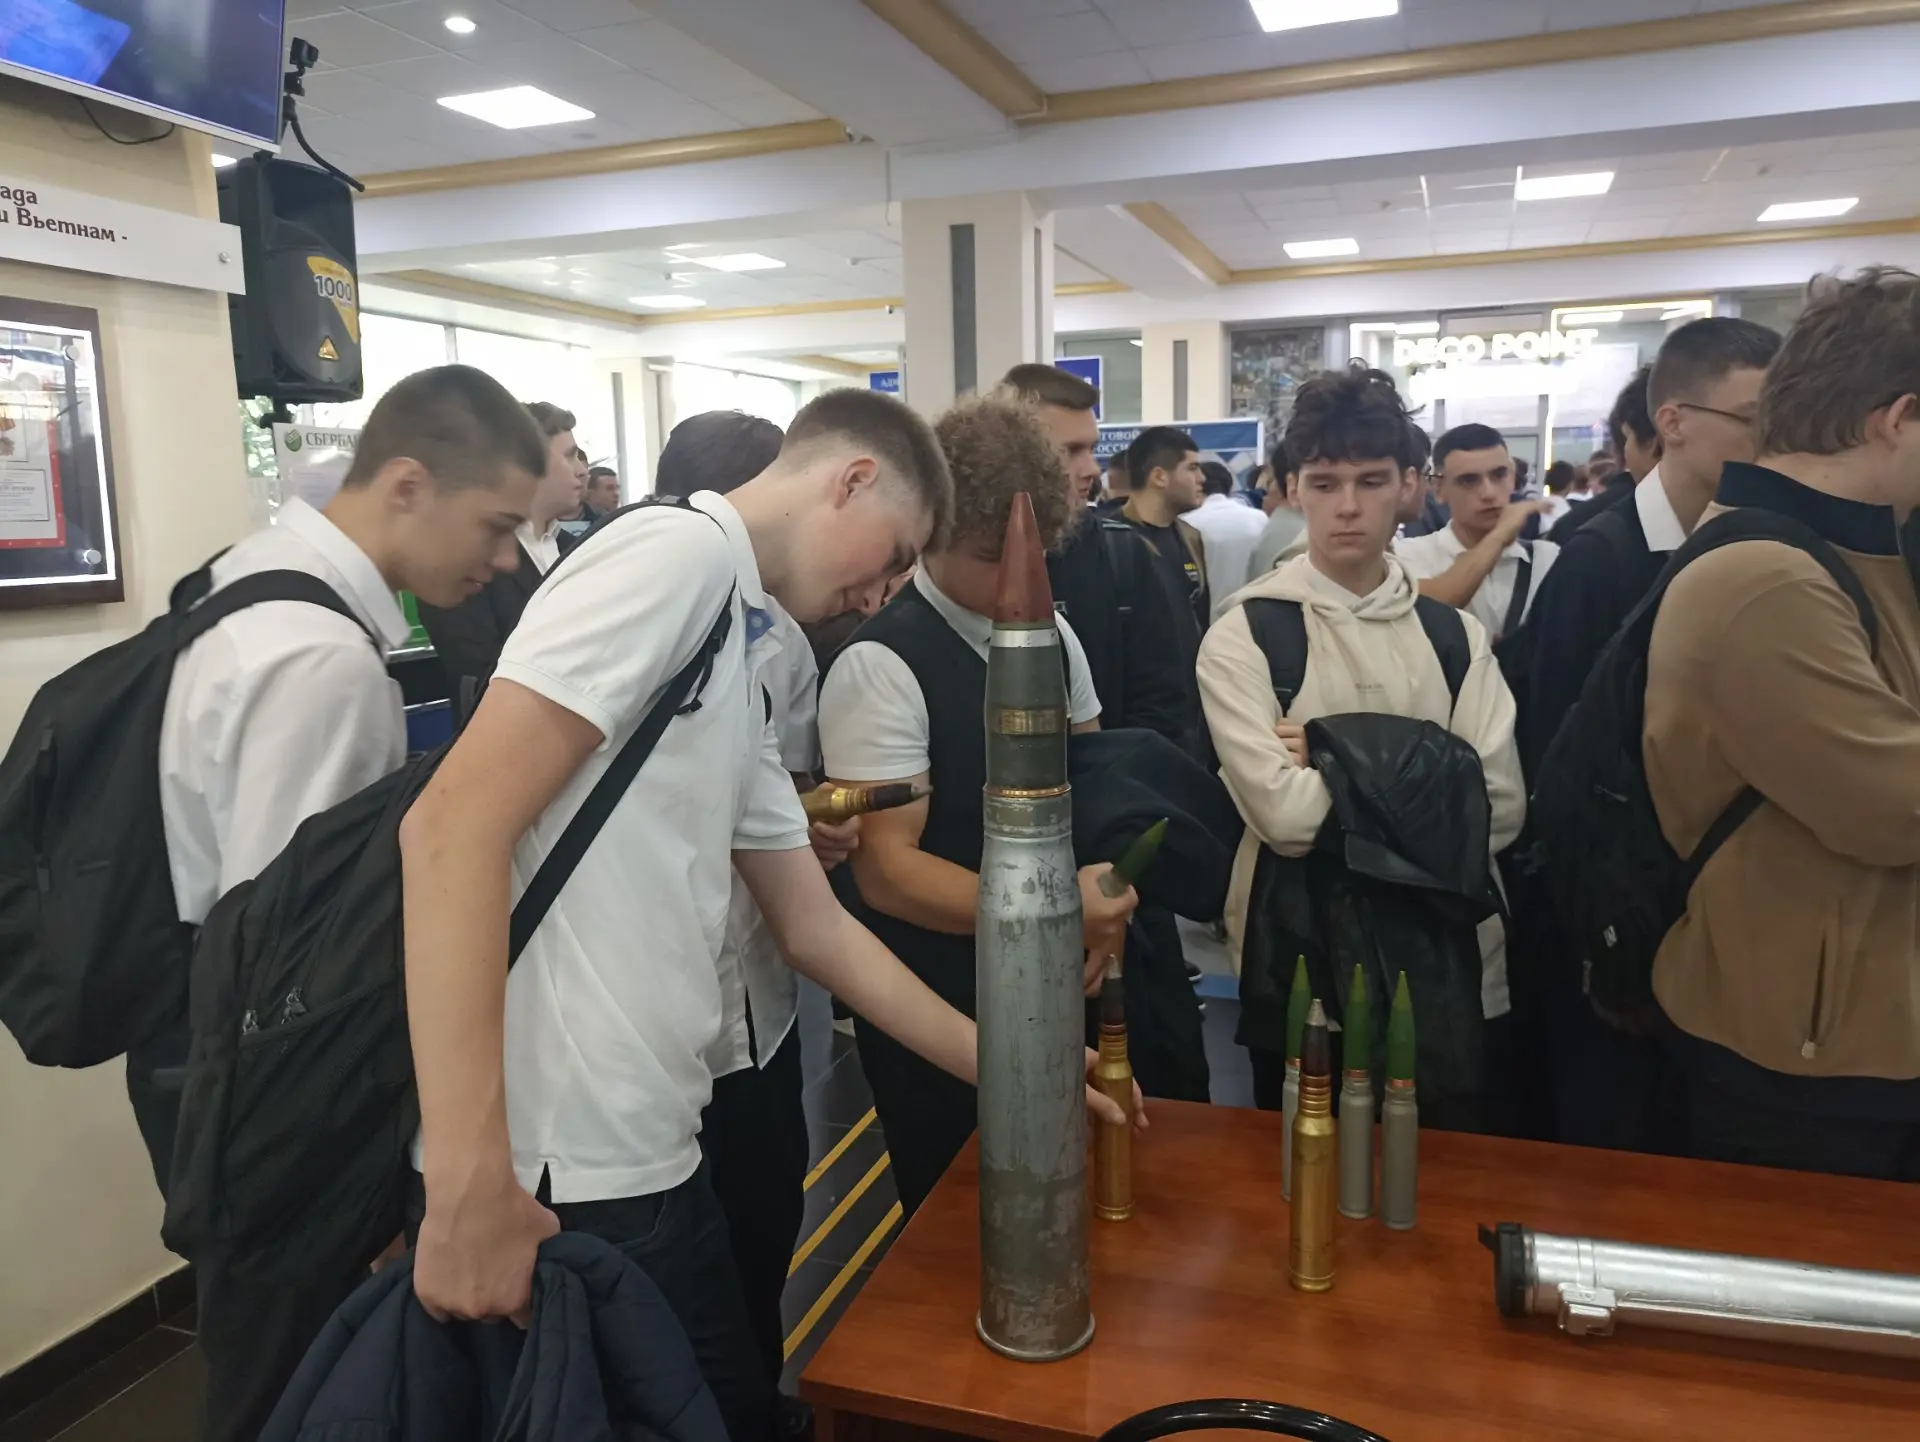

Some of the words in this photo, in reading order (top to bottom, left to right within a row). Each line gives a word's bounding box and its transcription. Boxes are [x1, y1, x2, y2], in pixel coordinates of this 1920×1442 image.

[16, 206, 116, 242] Вьетнам
[314, 275, 352, 302] 1000
[1393, 334, 1486, 367] DECO
